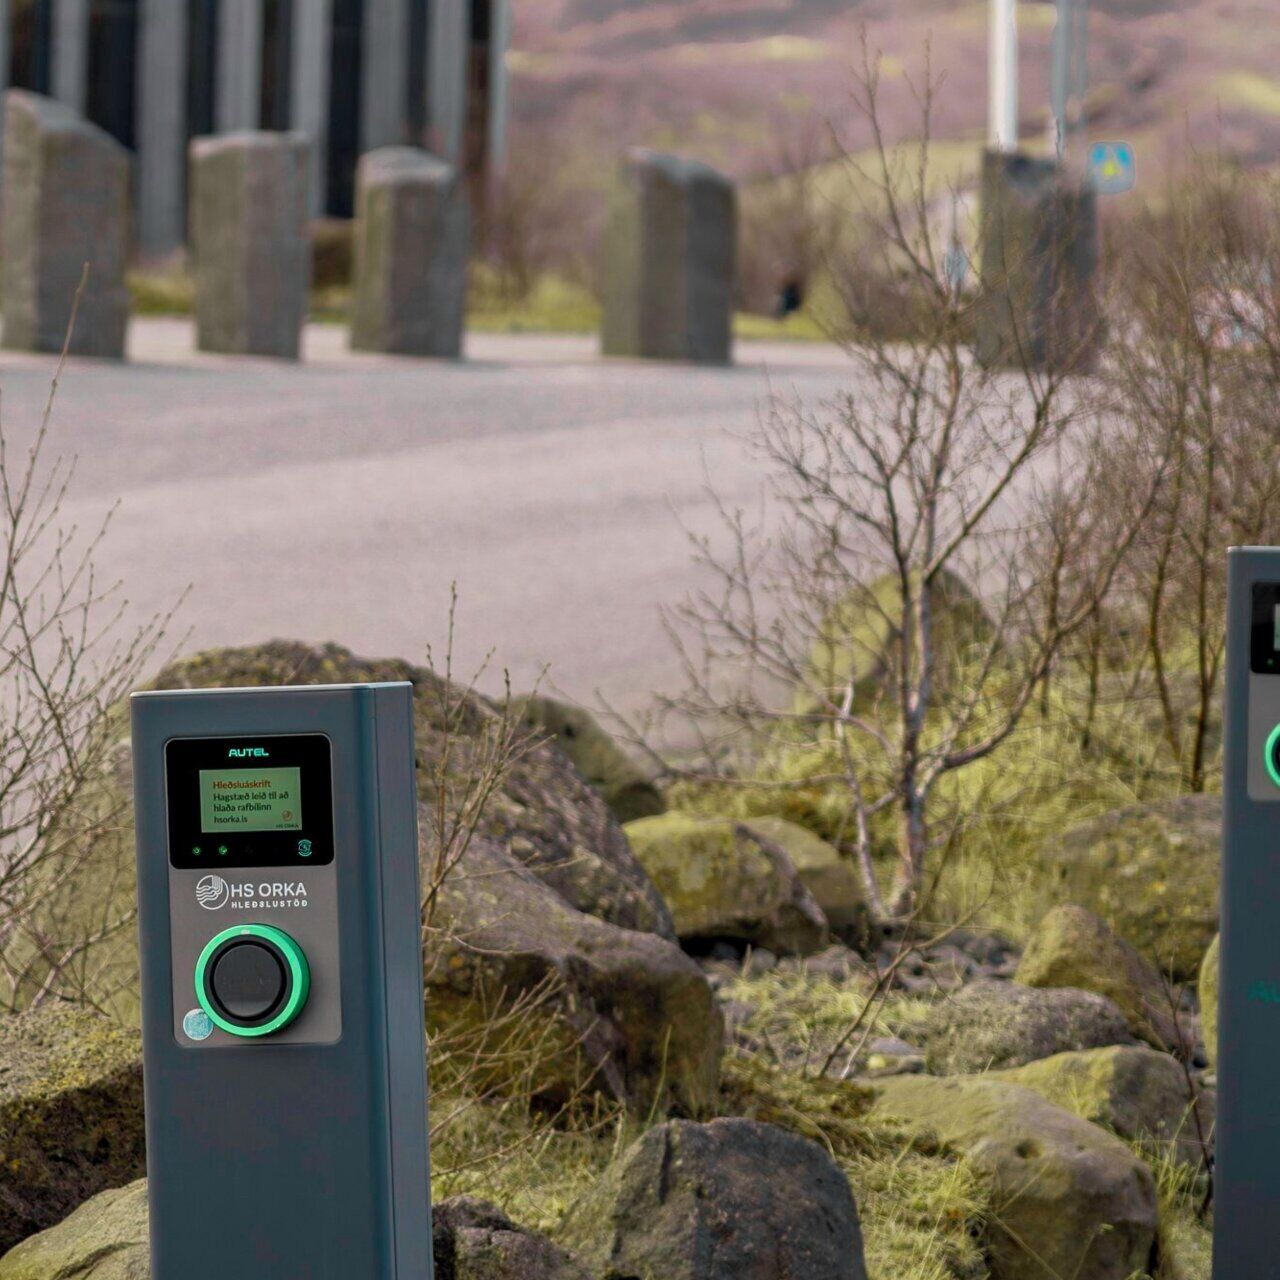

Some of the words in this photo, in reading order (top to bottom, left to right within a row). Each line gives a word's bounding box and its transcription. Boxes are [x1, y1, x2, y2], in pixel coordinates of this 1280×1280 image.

[228, 748, 269, 757] AUTEL
[213, 792, 250, 803] Hagstæð
[251, 792, 267, 801] leið
[268, 791, 277, 800] til
[278, 791, 290, 800] að
[213, 803, 236, 812] hlaða
[214, 814, 248, 824] hsorka.is
[231, 883, 255, 898] HS
[258, 882, 308, 898] ORKA
